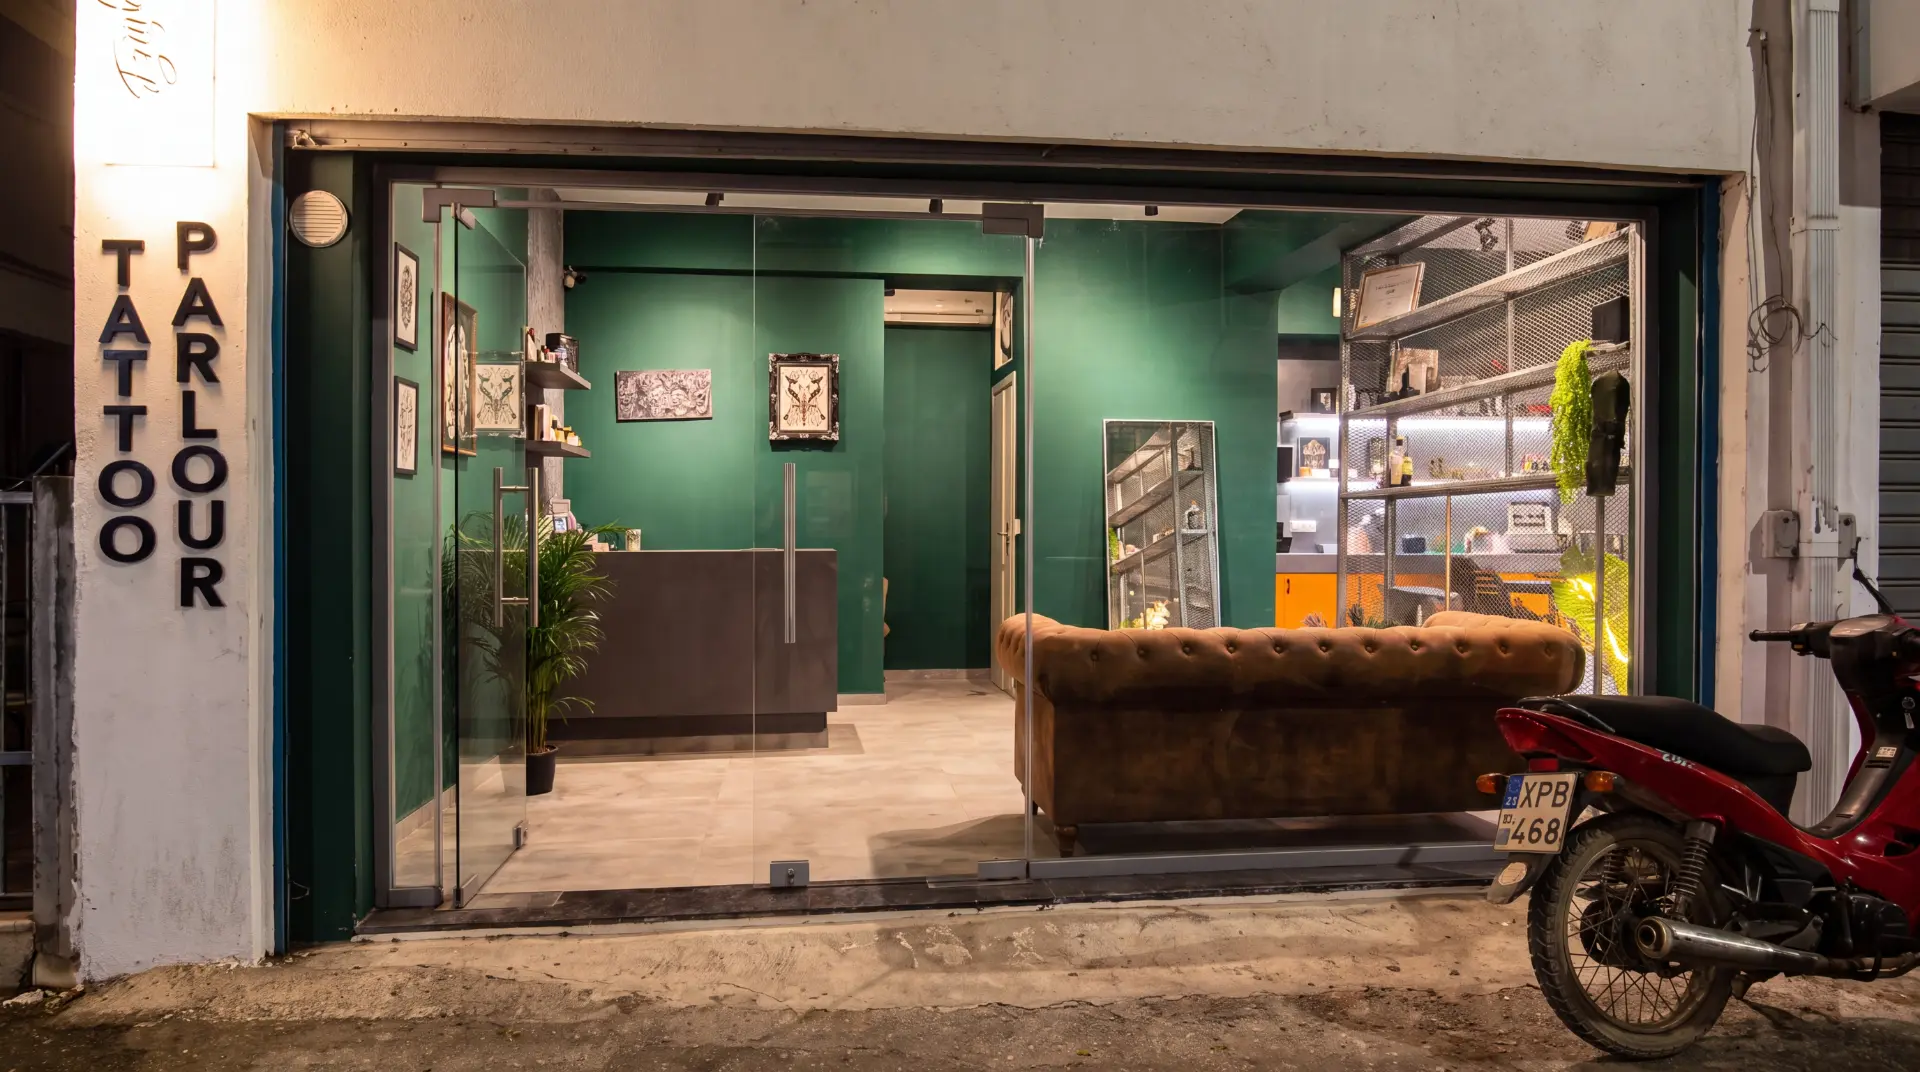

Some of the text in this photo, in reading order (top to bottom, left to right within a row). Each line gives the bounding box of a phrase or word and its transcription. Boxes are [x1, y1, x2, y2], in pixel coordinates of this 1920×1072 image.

[98, 239, 156, 562] TATTOO
[171, 221, 228, 608] PARLOUR
[1511, 818, 1561, 845] 468
[1519, 781, 1570, 808] XPB
